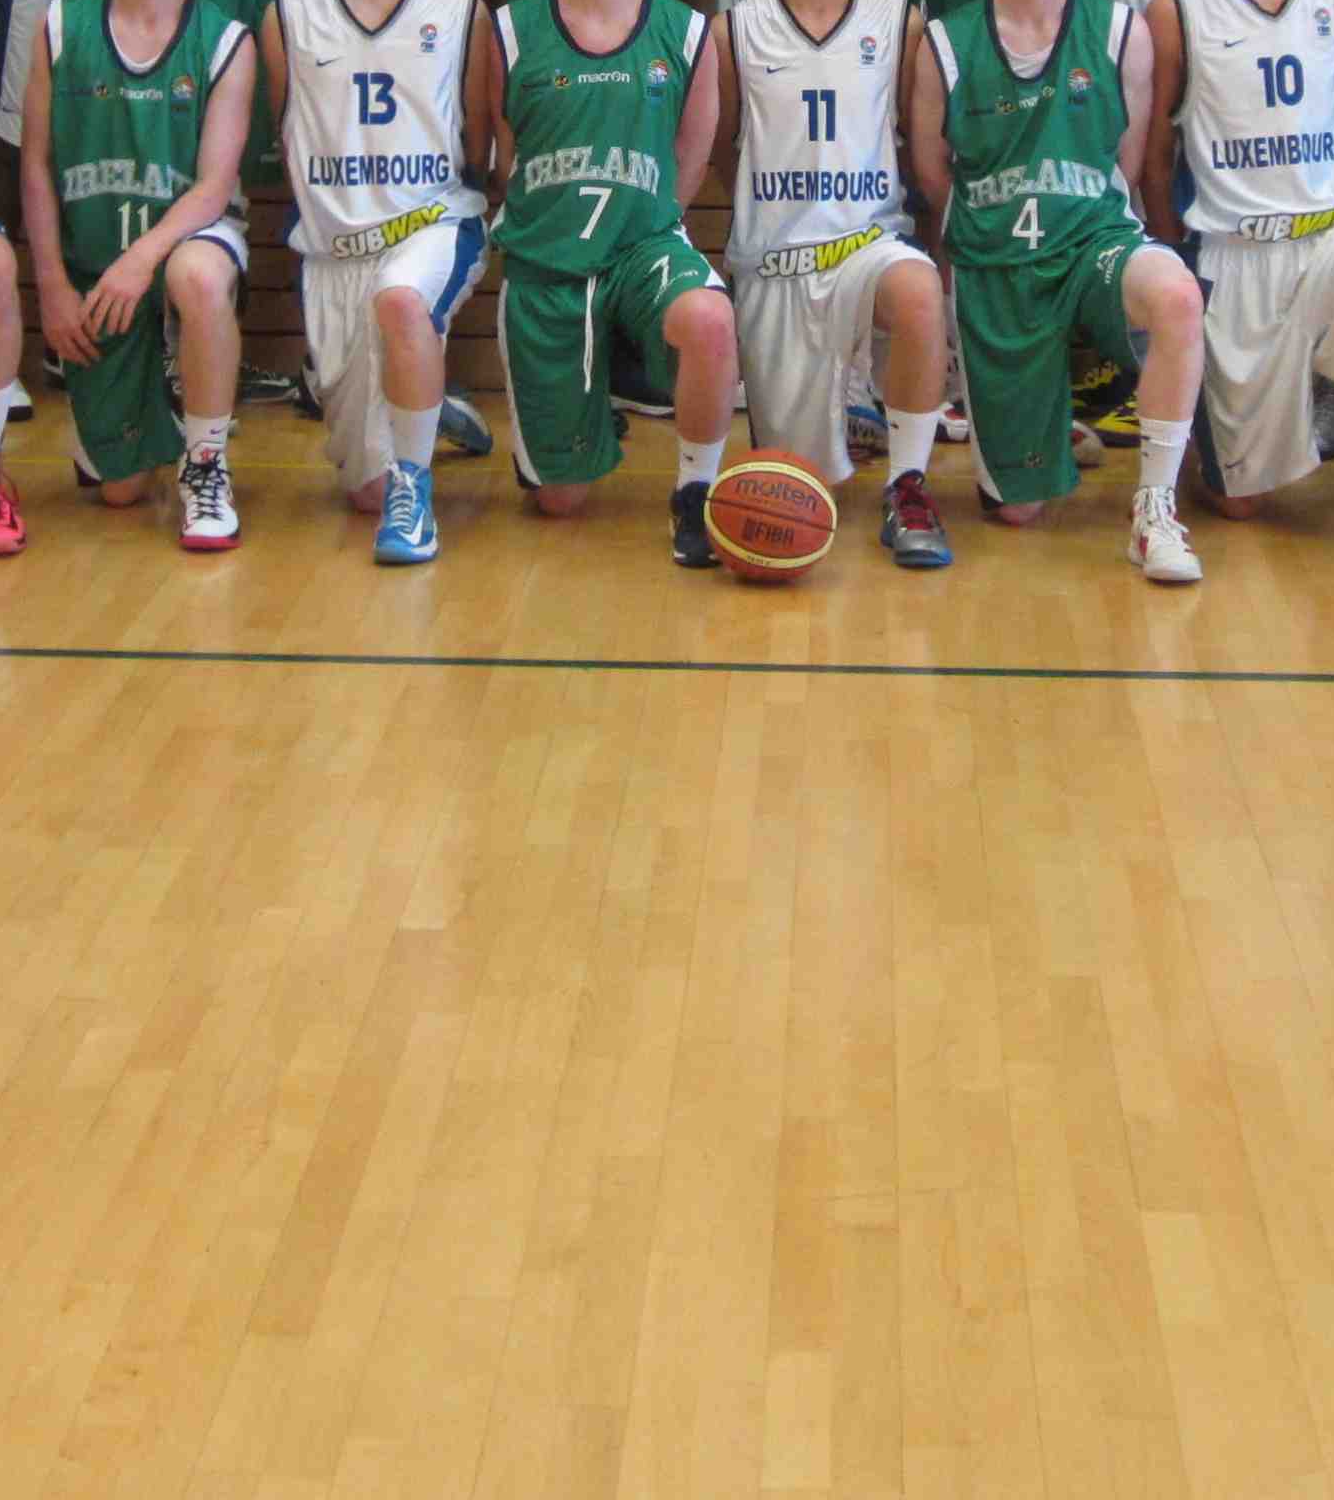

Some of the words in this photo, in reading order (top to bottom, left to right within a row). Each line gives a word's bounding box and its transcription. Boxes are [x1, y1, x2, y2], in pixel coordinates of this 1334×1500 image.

[353, 72, 398, 125] 13
[578, 71, 631, 86] macron
[1257, 55, 1305, 109] 10
[801, 88, 836, 142] 11
[308, 153, 450, 187] LUXEMBOURG
[753, 169, 890, 203] LUXEMBOURG
[118, 201, 150, 250] 11
[332, 201, 448, 259] SUBWAY
[578, 186, 613, 240] 7
[1012, 197, 1046, 250] 4
[759, 224, 884, 279] SUBWAY
[734, 476, 819, 512] molten
[754, 517, 795, 547] FIBA
